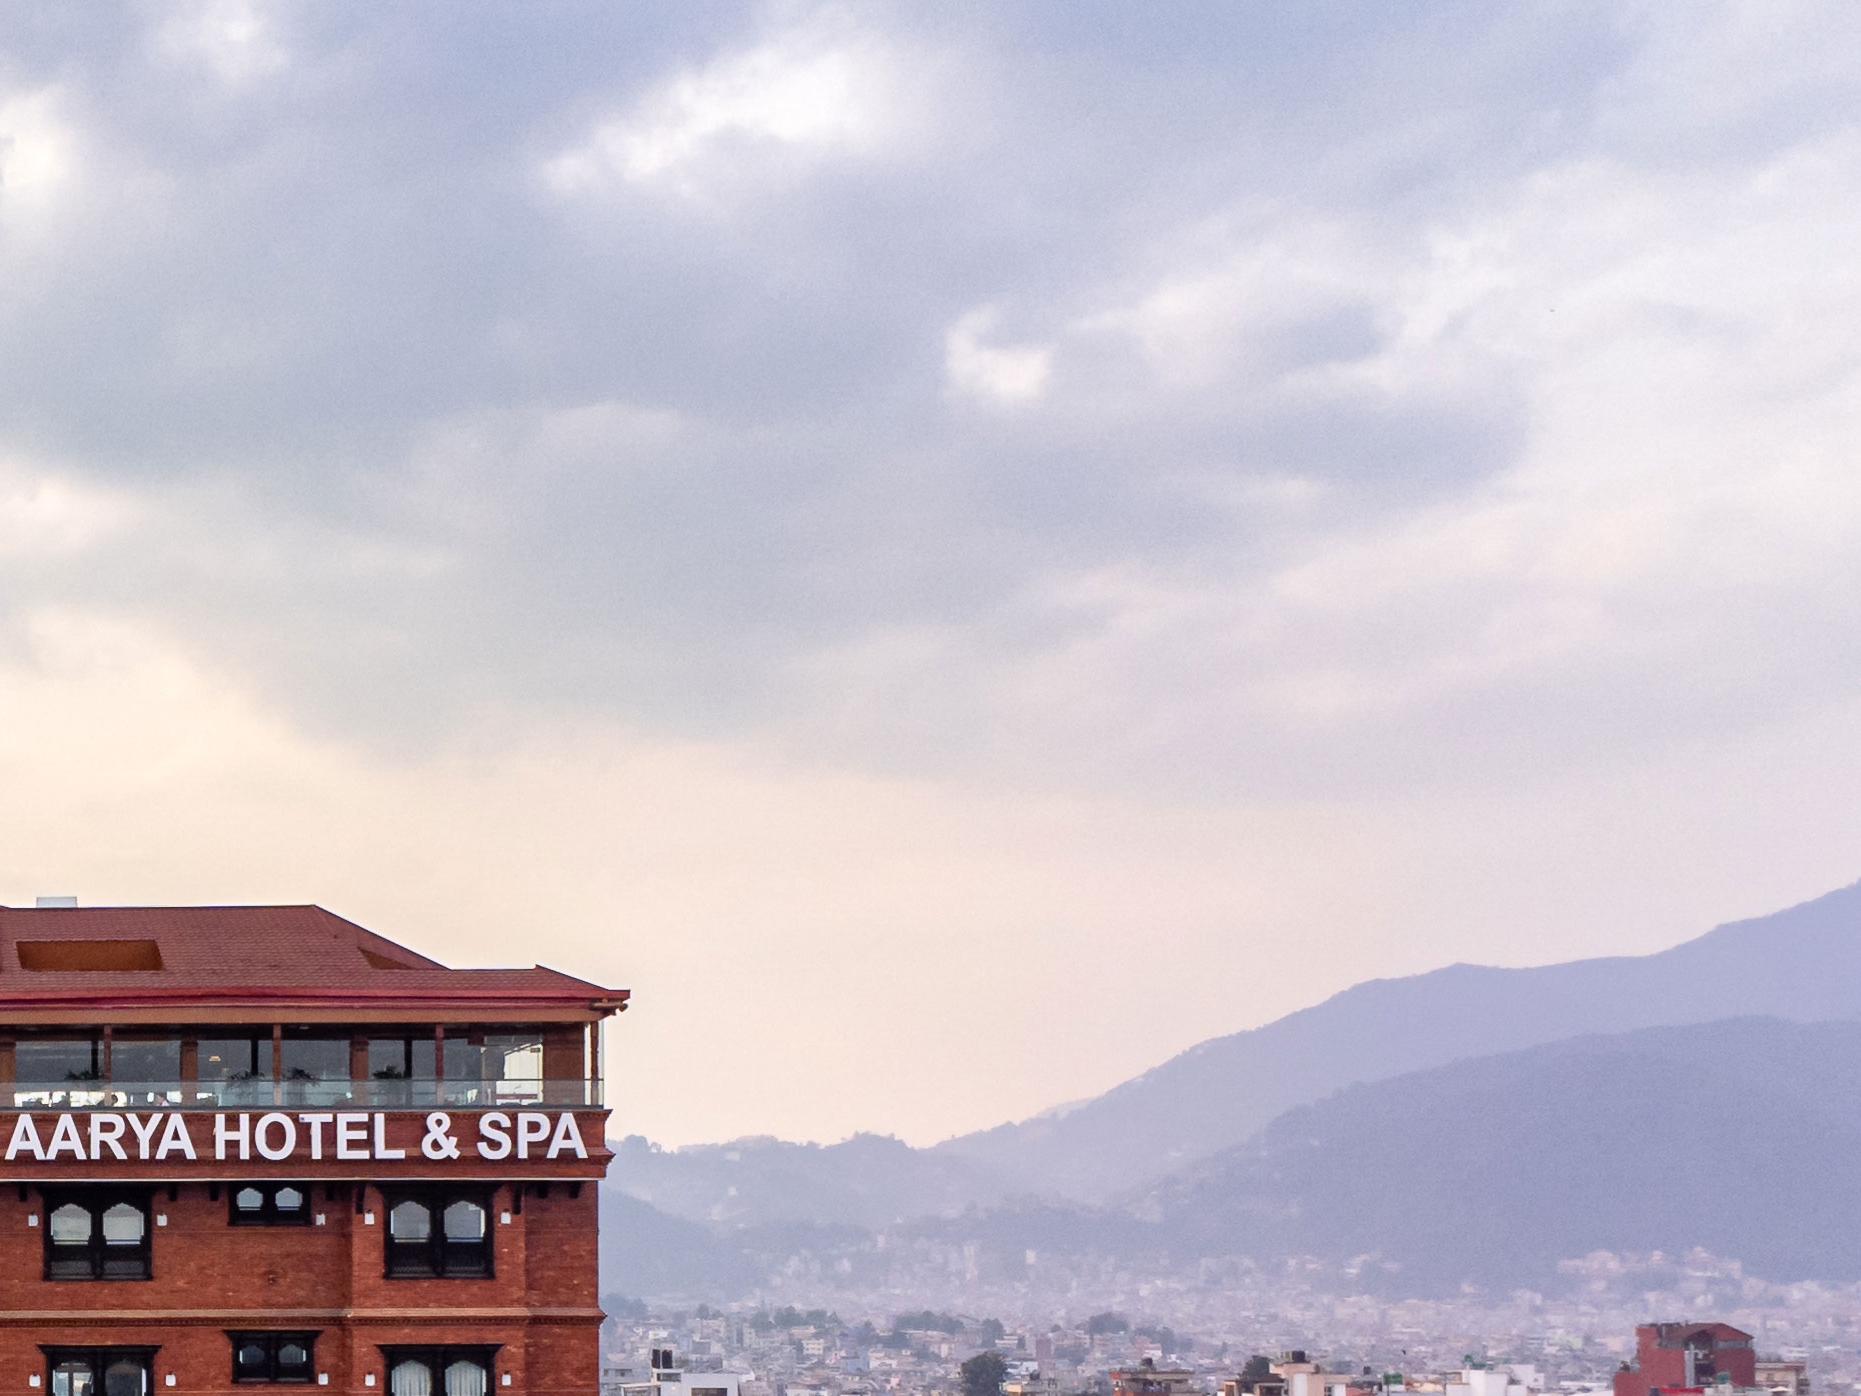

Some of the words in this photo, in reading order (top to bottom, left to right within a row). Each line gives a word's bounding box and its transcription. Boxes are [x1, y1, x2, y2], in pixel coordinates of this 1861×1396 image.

[4, 1113, 197, 1161] AARYA
[214, 1112, 406, 1161] HOTEL
[420, 1112, 461, 1161] &
[476, 1112, 589, 1161] SPA
